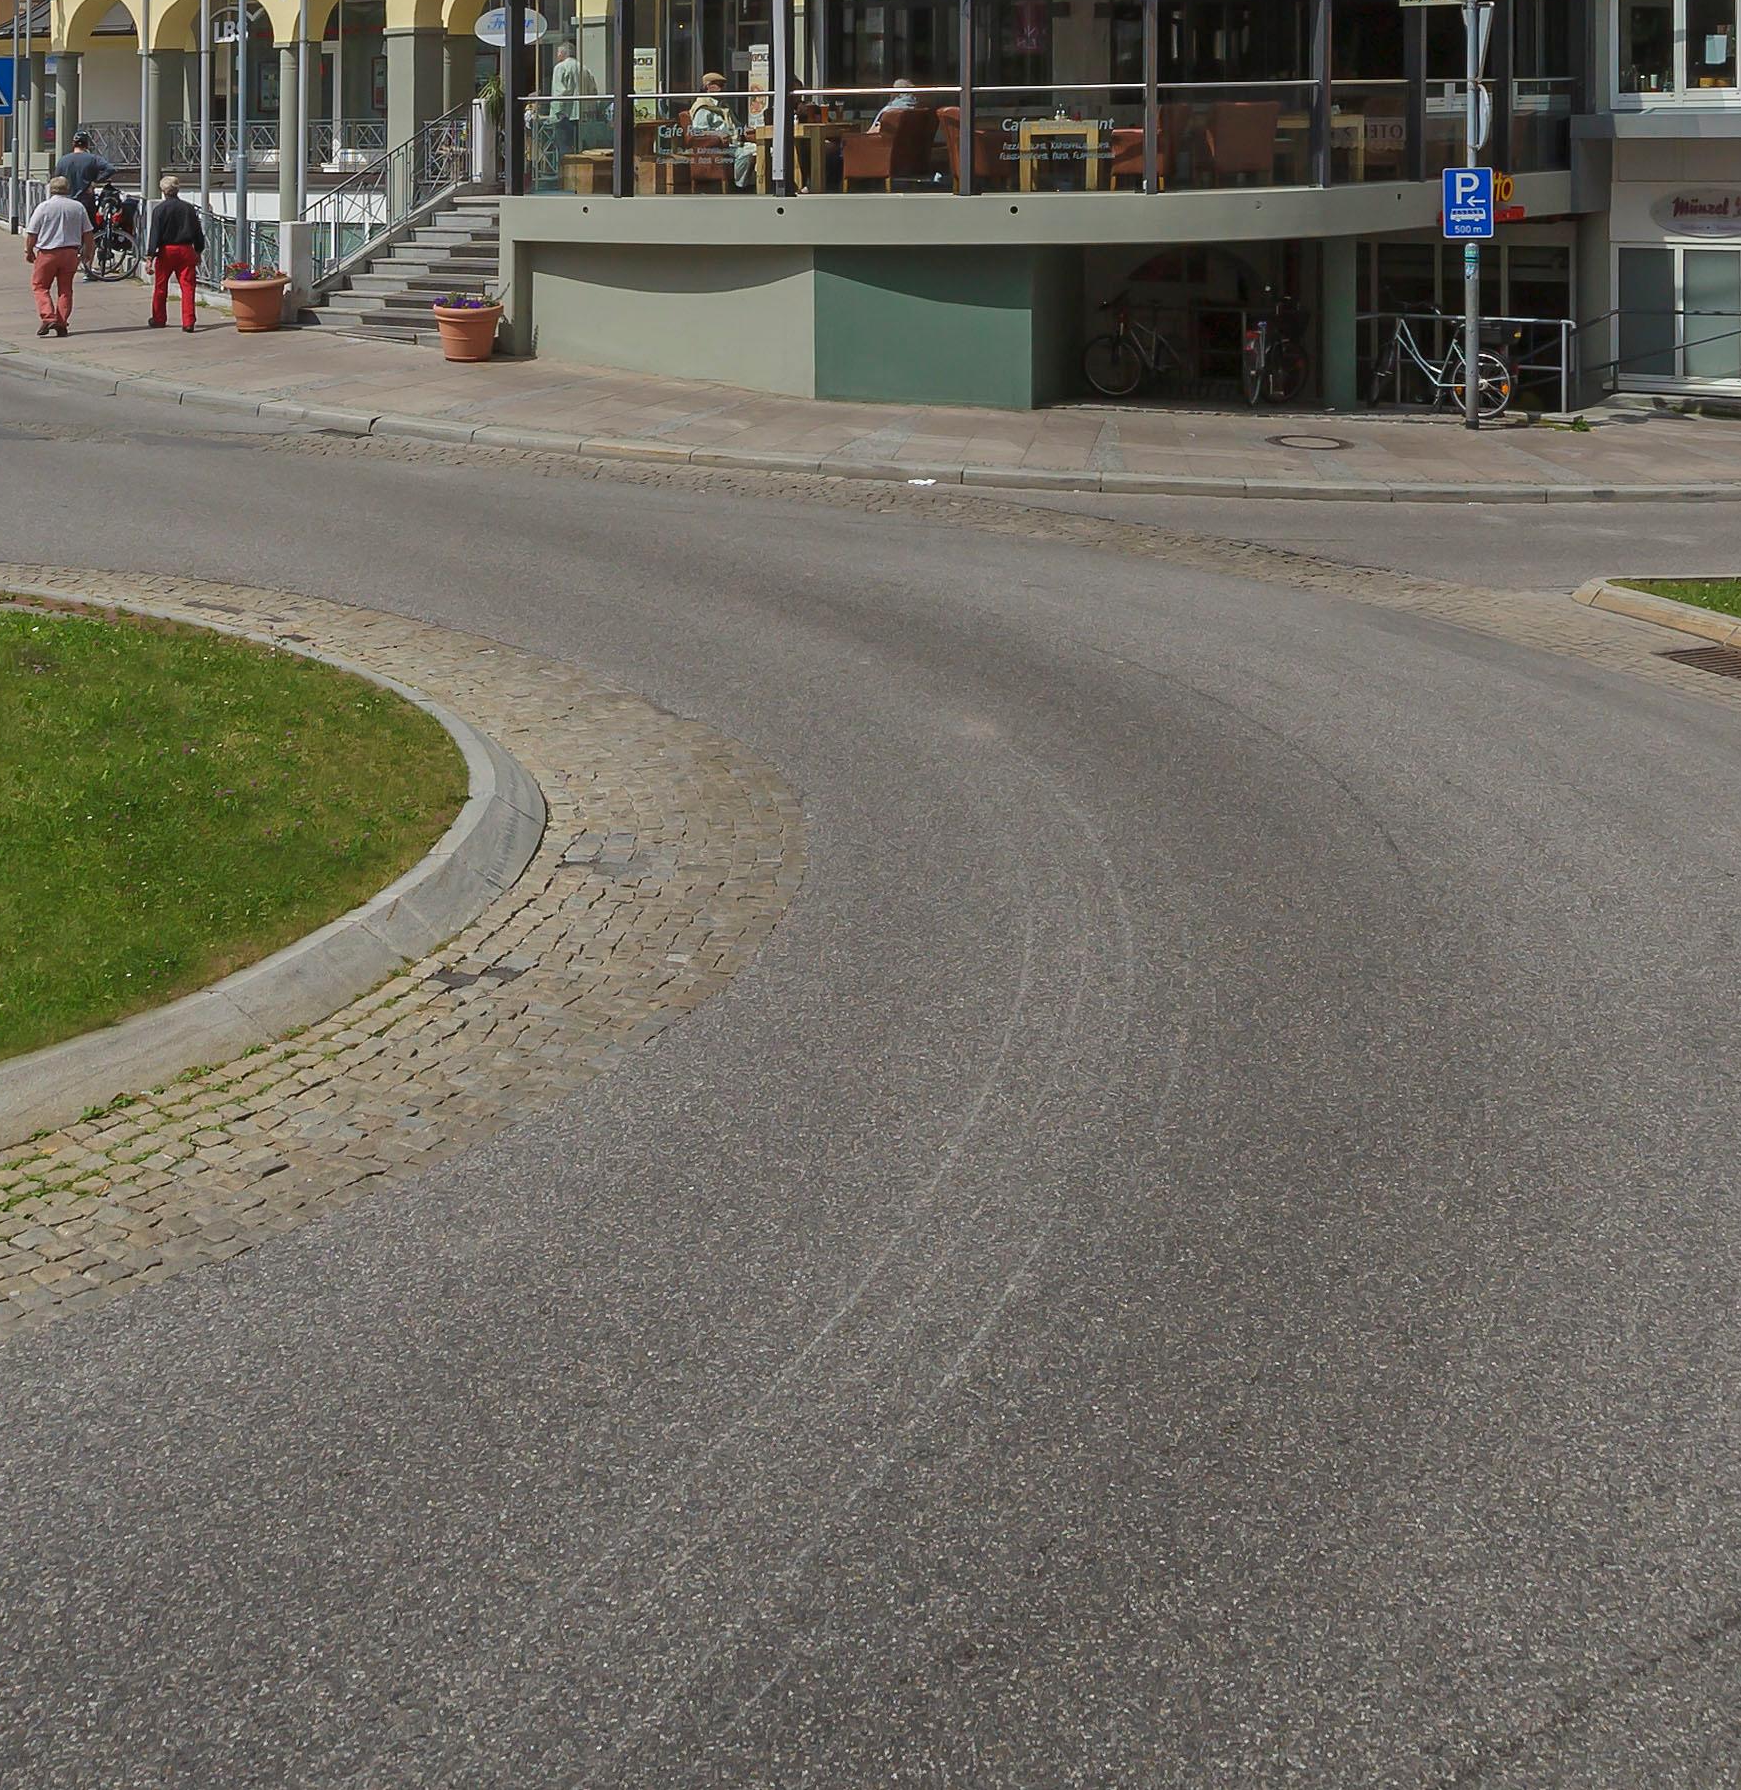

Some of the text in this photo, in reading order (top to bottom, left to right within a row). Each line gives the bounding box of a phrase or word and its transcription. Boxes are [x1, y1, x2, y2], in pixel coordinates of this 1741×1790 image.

[1456, 173, 1479, 204] P
[1672, 196, 1729, 218] Münzel
[1454, 225, 1471, 234] 500
